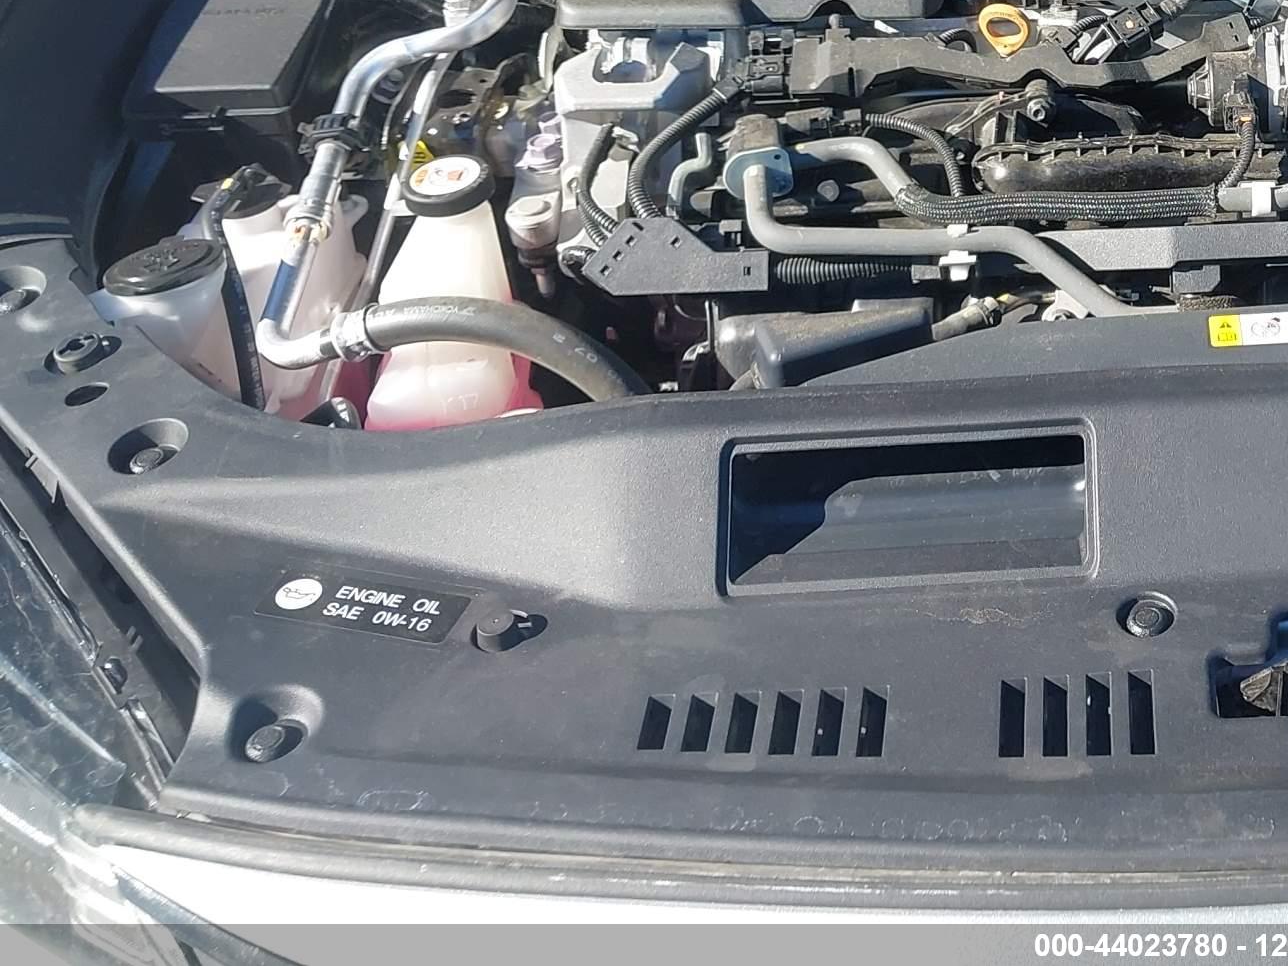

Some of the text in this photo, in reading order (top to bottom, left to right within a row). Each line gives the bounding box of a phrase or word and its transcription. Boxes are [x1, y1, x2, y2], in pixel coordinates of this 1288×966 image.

[335, 585, 441, 615] ENGINE OIL
[322, 602, 433, 632] SAE 0W-16
